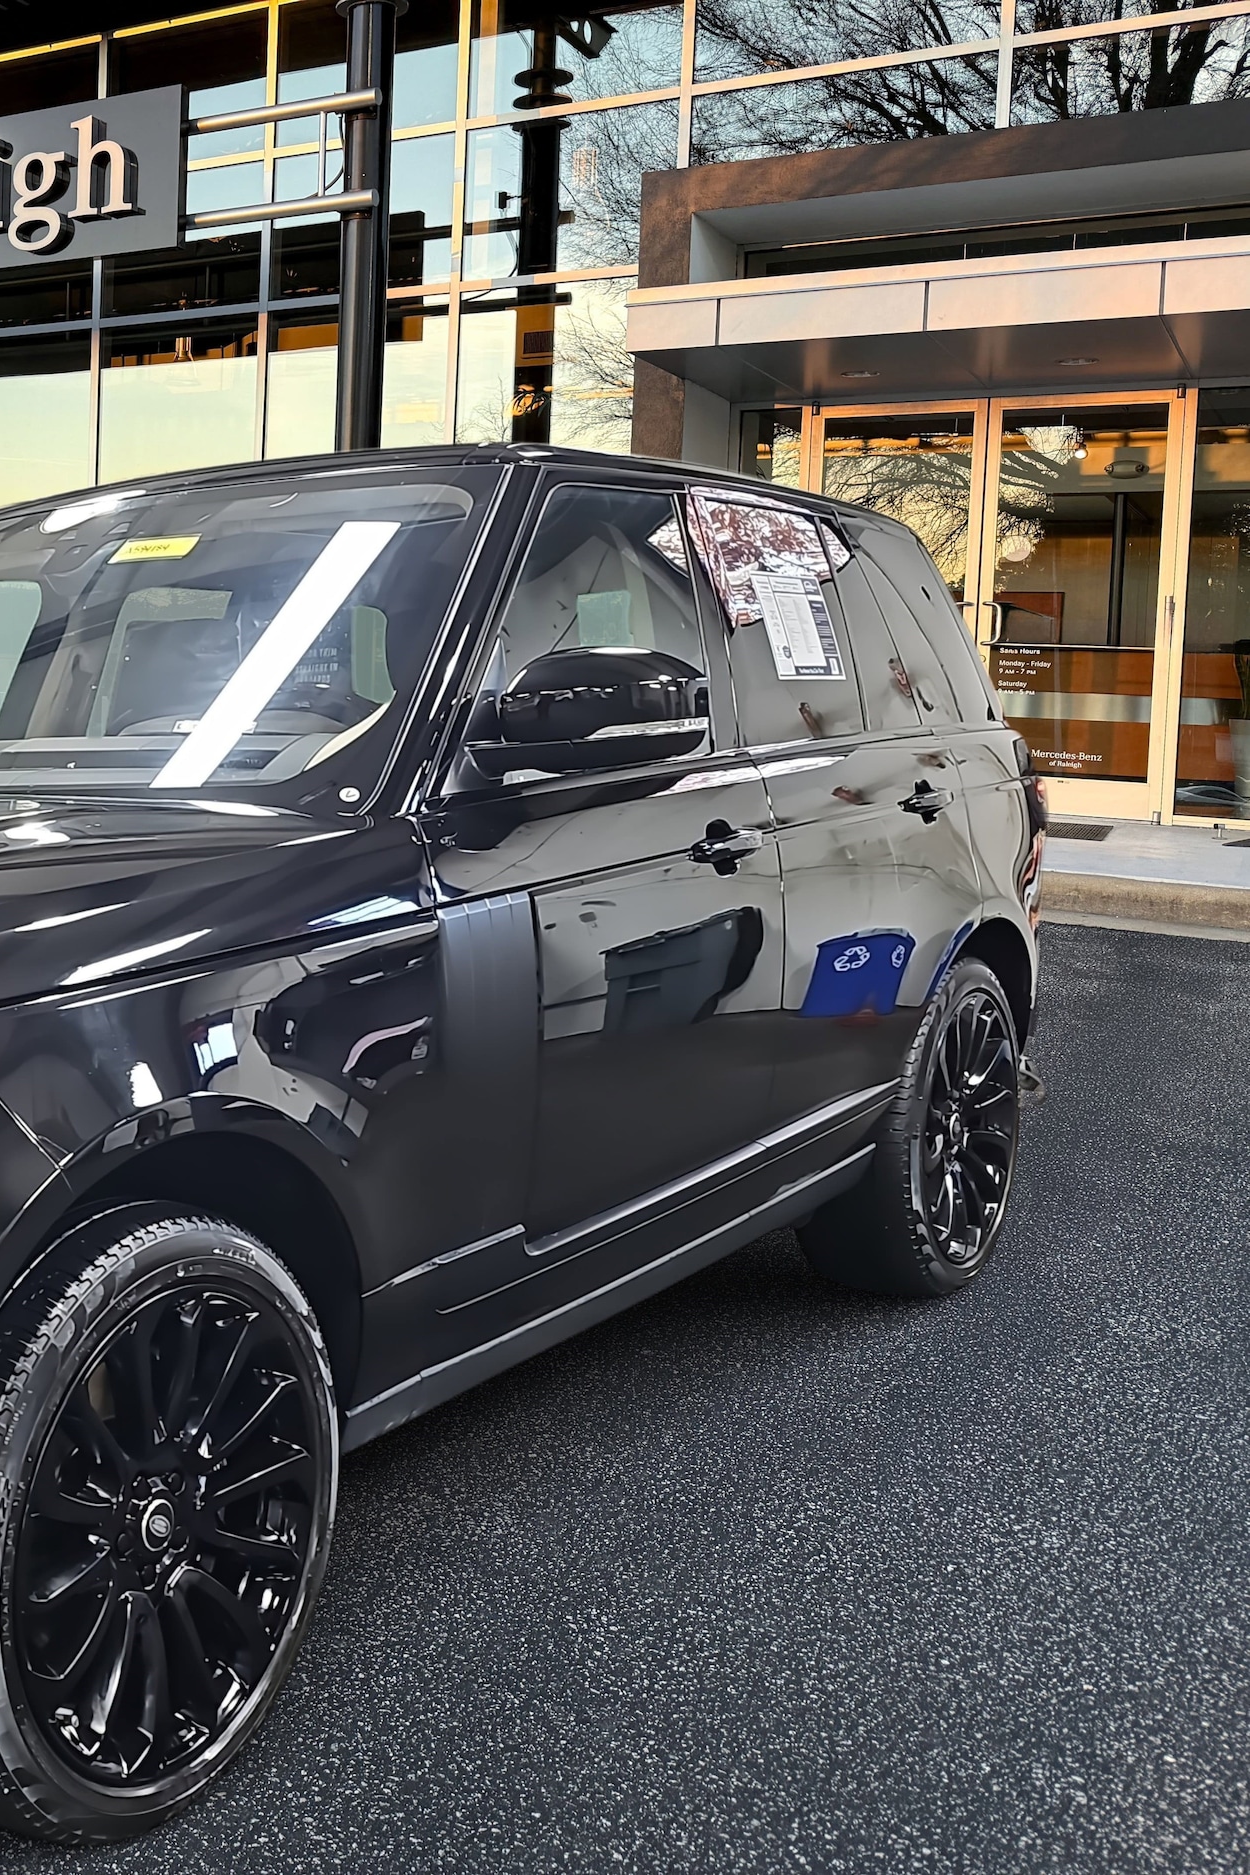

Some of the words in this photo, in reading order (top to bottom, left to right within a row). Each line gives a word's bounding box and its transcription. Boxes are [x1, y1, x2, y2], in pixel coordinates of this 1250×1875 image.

[999, 660, 1025, 668] Monday
[1031, 660, 1051, 668] Friday
[998, 680, 1027, 688] Saturday
[1031, 749, 1102, 762] Mercedes-Benz
[1057, 760, 1082, 769] Raleigh
